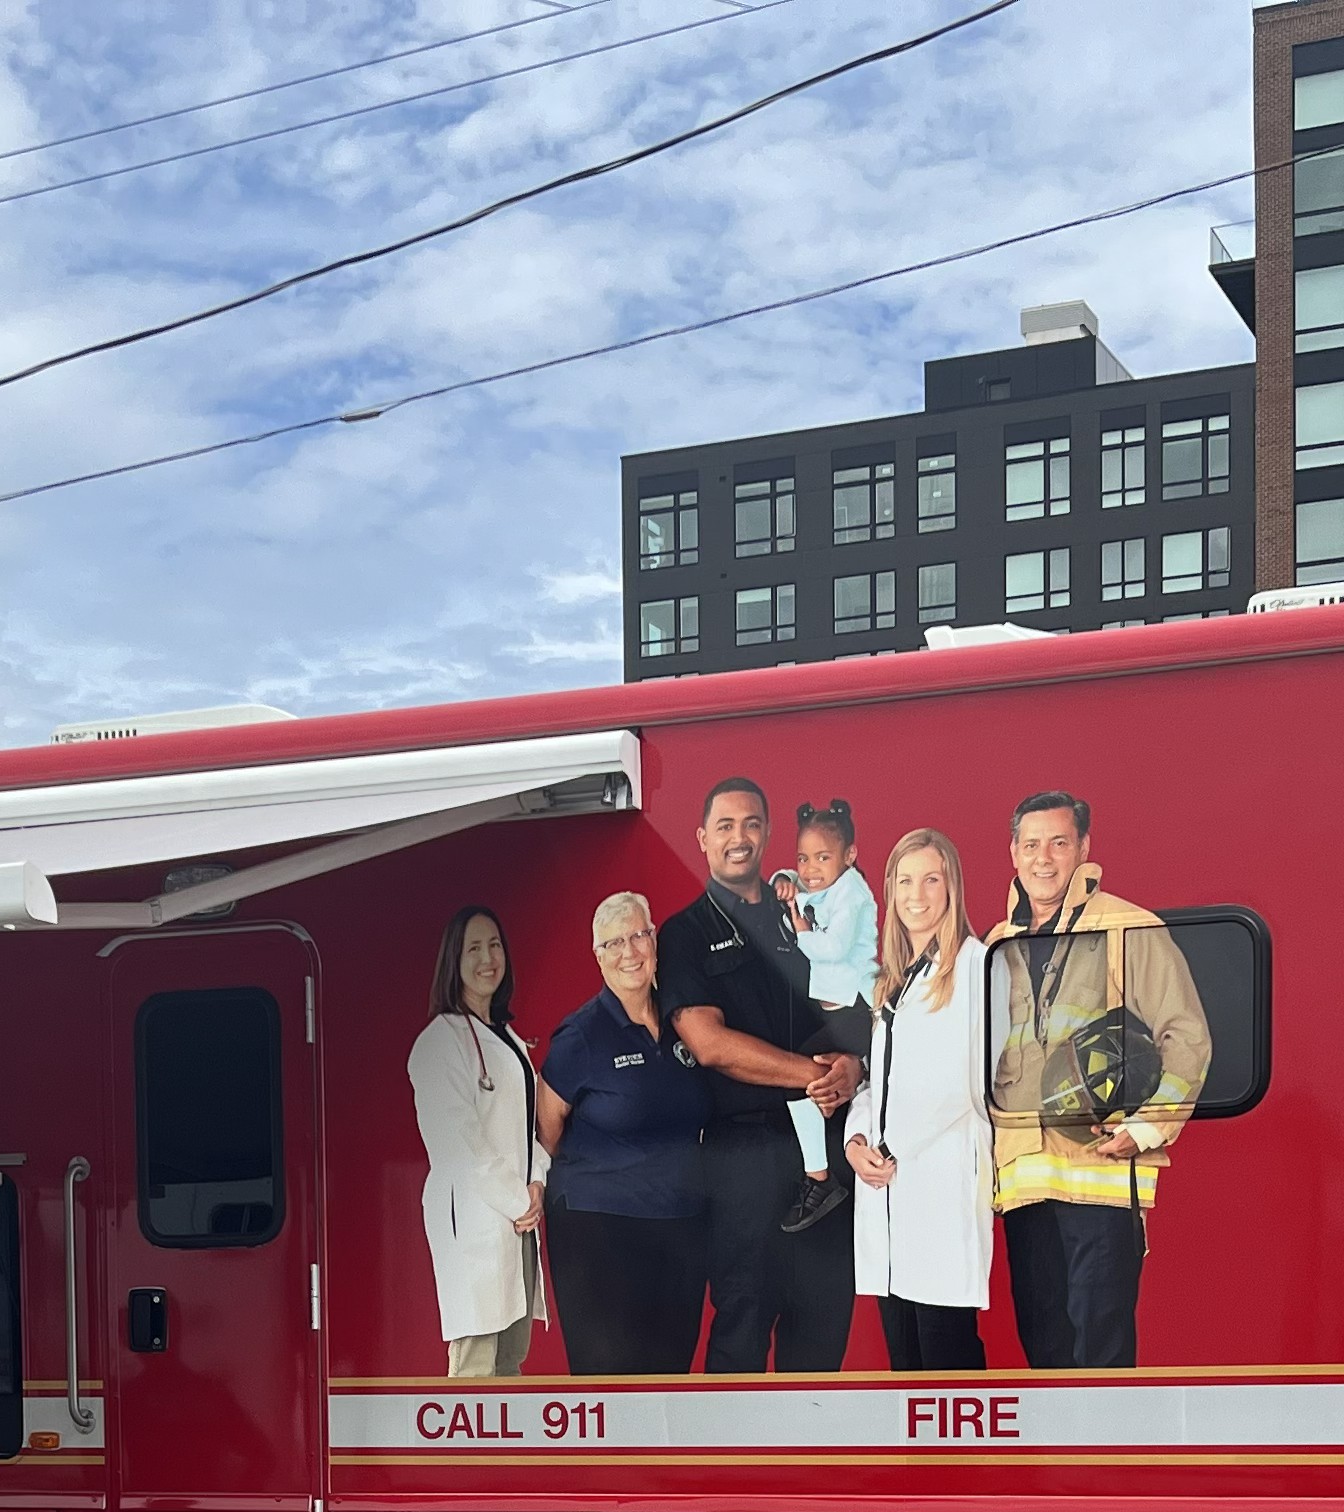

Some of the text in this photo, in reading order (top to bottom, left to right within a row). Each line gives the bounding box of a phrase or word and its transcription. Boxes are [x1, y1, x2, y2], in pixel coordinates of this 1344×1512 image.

[416, 1401, 606, 1440] CALL 911
[907, 1397, 1020, 1438] FIRE
